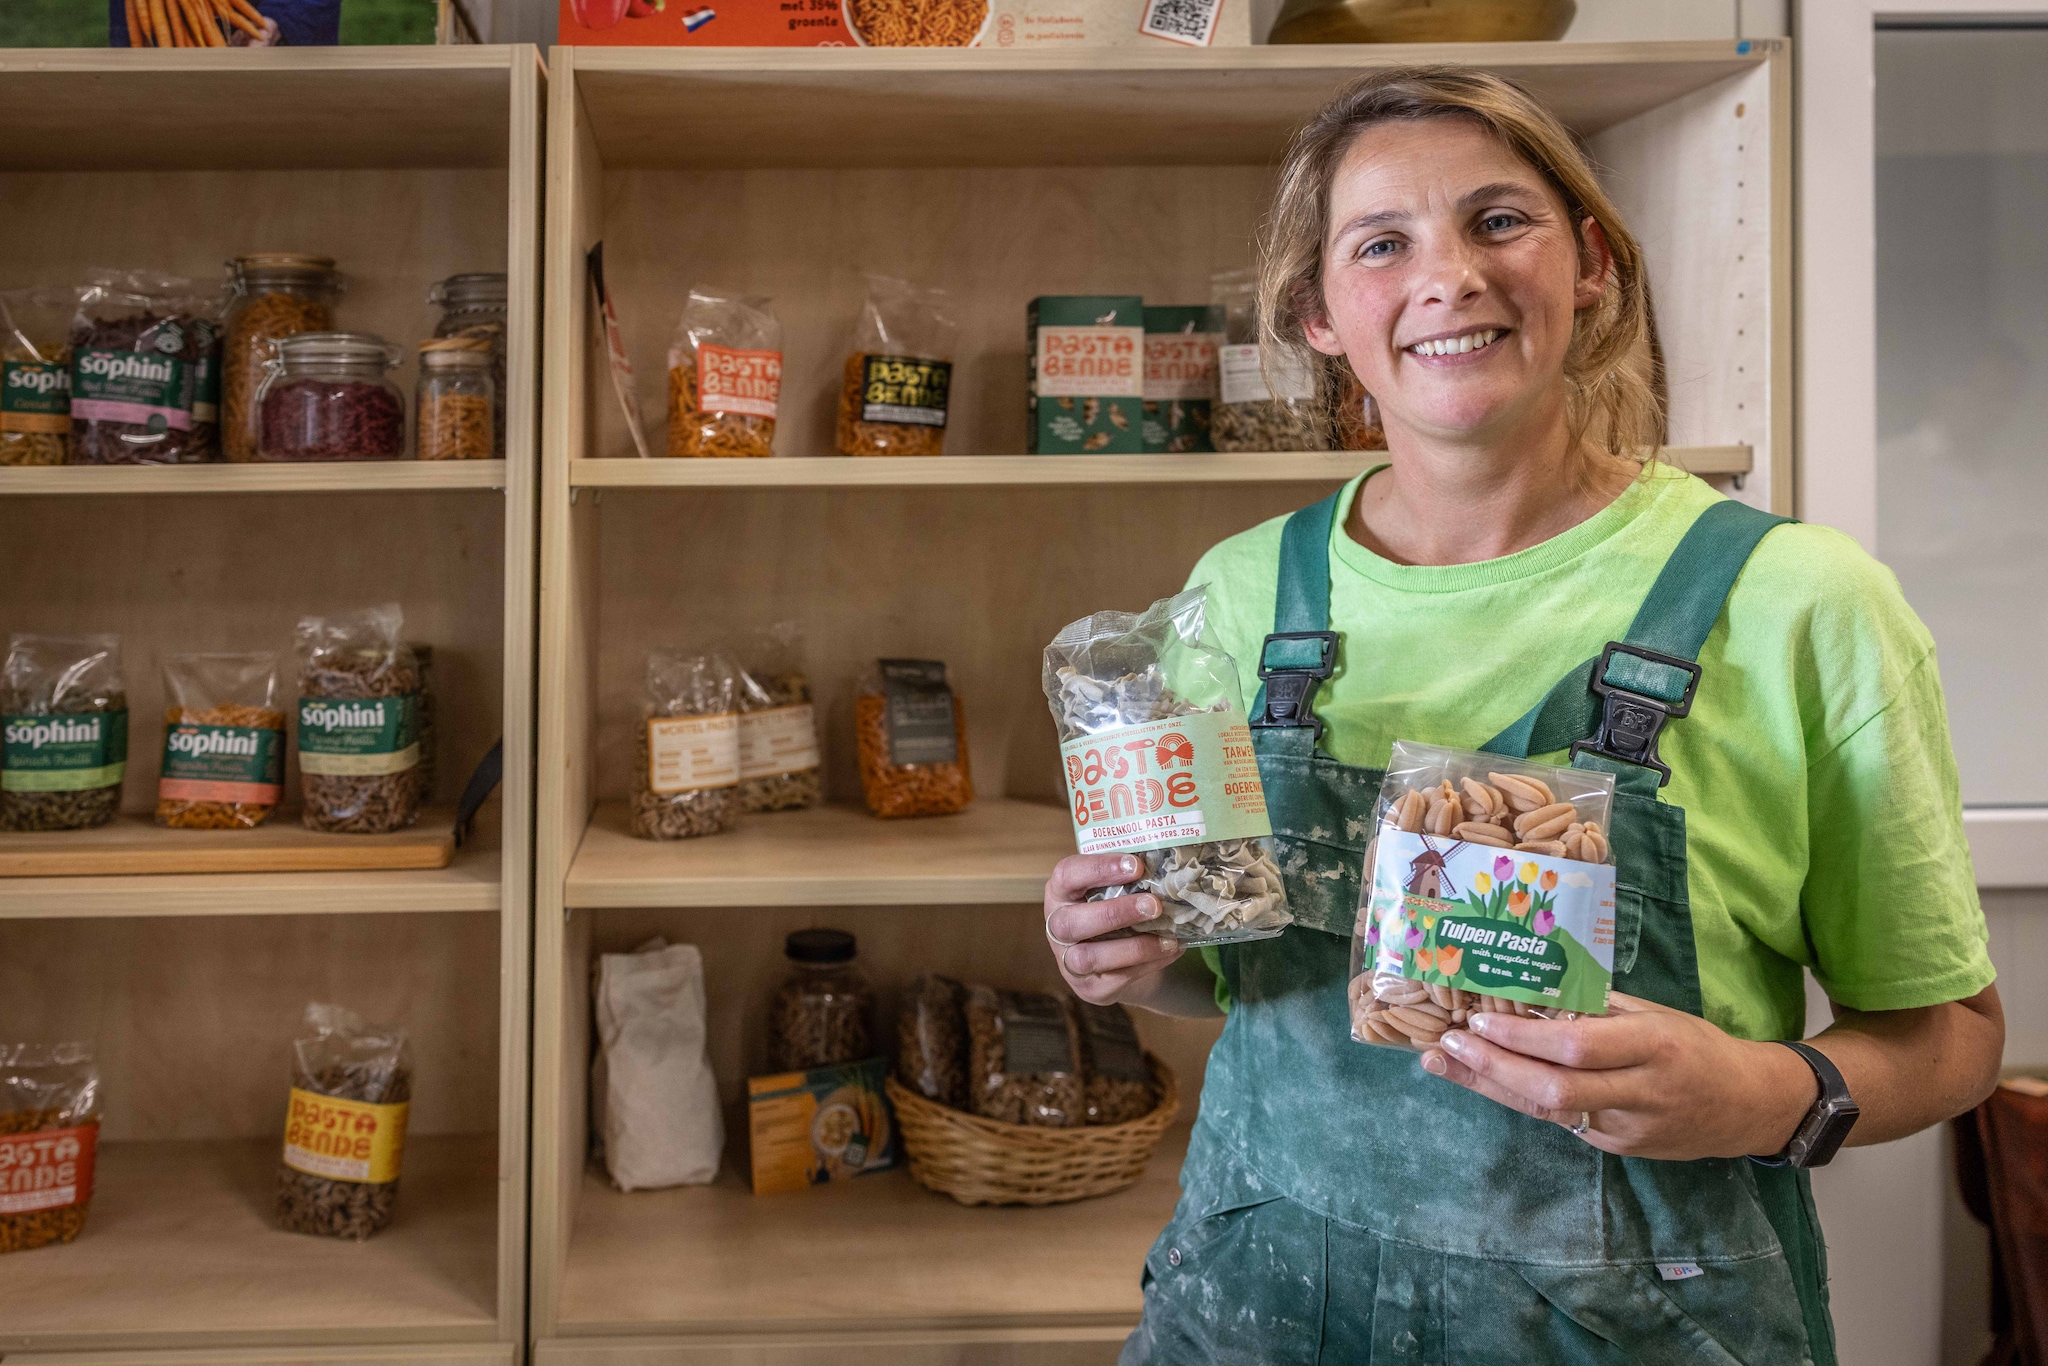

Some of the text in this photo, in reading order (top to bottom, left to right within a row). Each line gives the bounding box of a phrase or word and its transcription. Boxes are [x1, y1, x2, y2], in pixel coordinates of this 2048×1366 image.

[788, 16, 838, 30] groente
[1045, 335, 1134, 355] PASTA
[1043, 356, 1132, 377] BENDE
[301, 702, 385, 732] sophini
[4, 717, 100, 749] sophini
[168, 728, 258, 758] sophini
[1092, 814, 1176, 838] BOERENKOOL PASTA
[1095, 841, 1116, 851] BINNEN
[1132, 834, 1146, 844] VOOR
[1160, 829, 1180, 838] PERS.
[1181, 827, 1200, 837] 225g
[1440, 919, 1549, 956] Tulpen Pasta
[1472, 948, 1562, 971] with upcycled veggies
[1541, 986, 1562, 998] 225g
[291, 1100, 377, 1135] PASTA
[0, 1136, 80, 1168] ASTA
